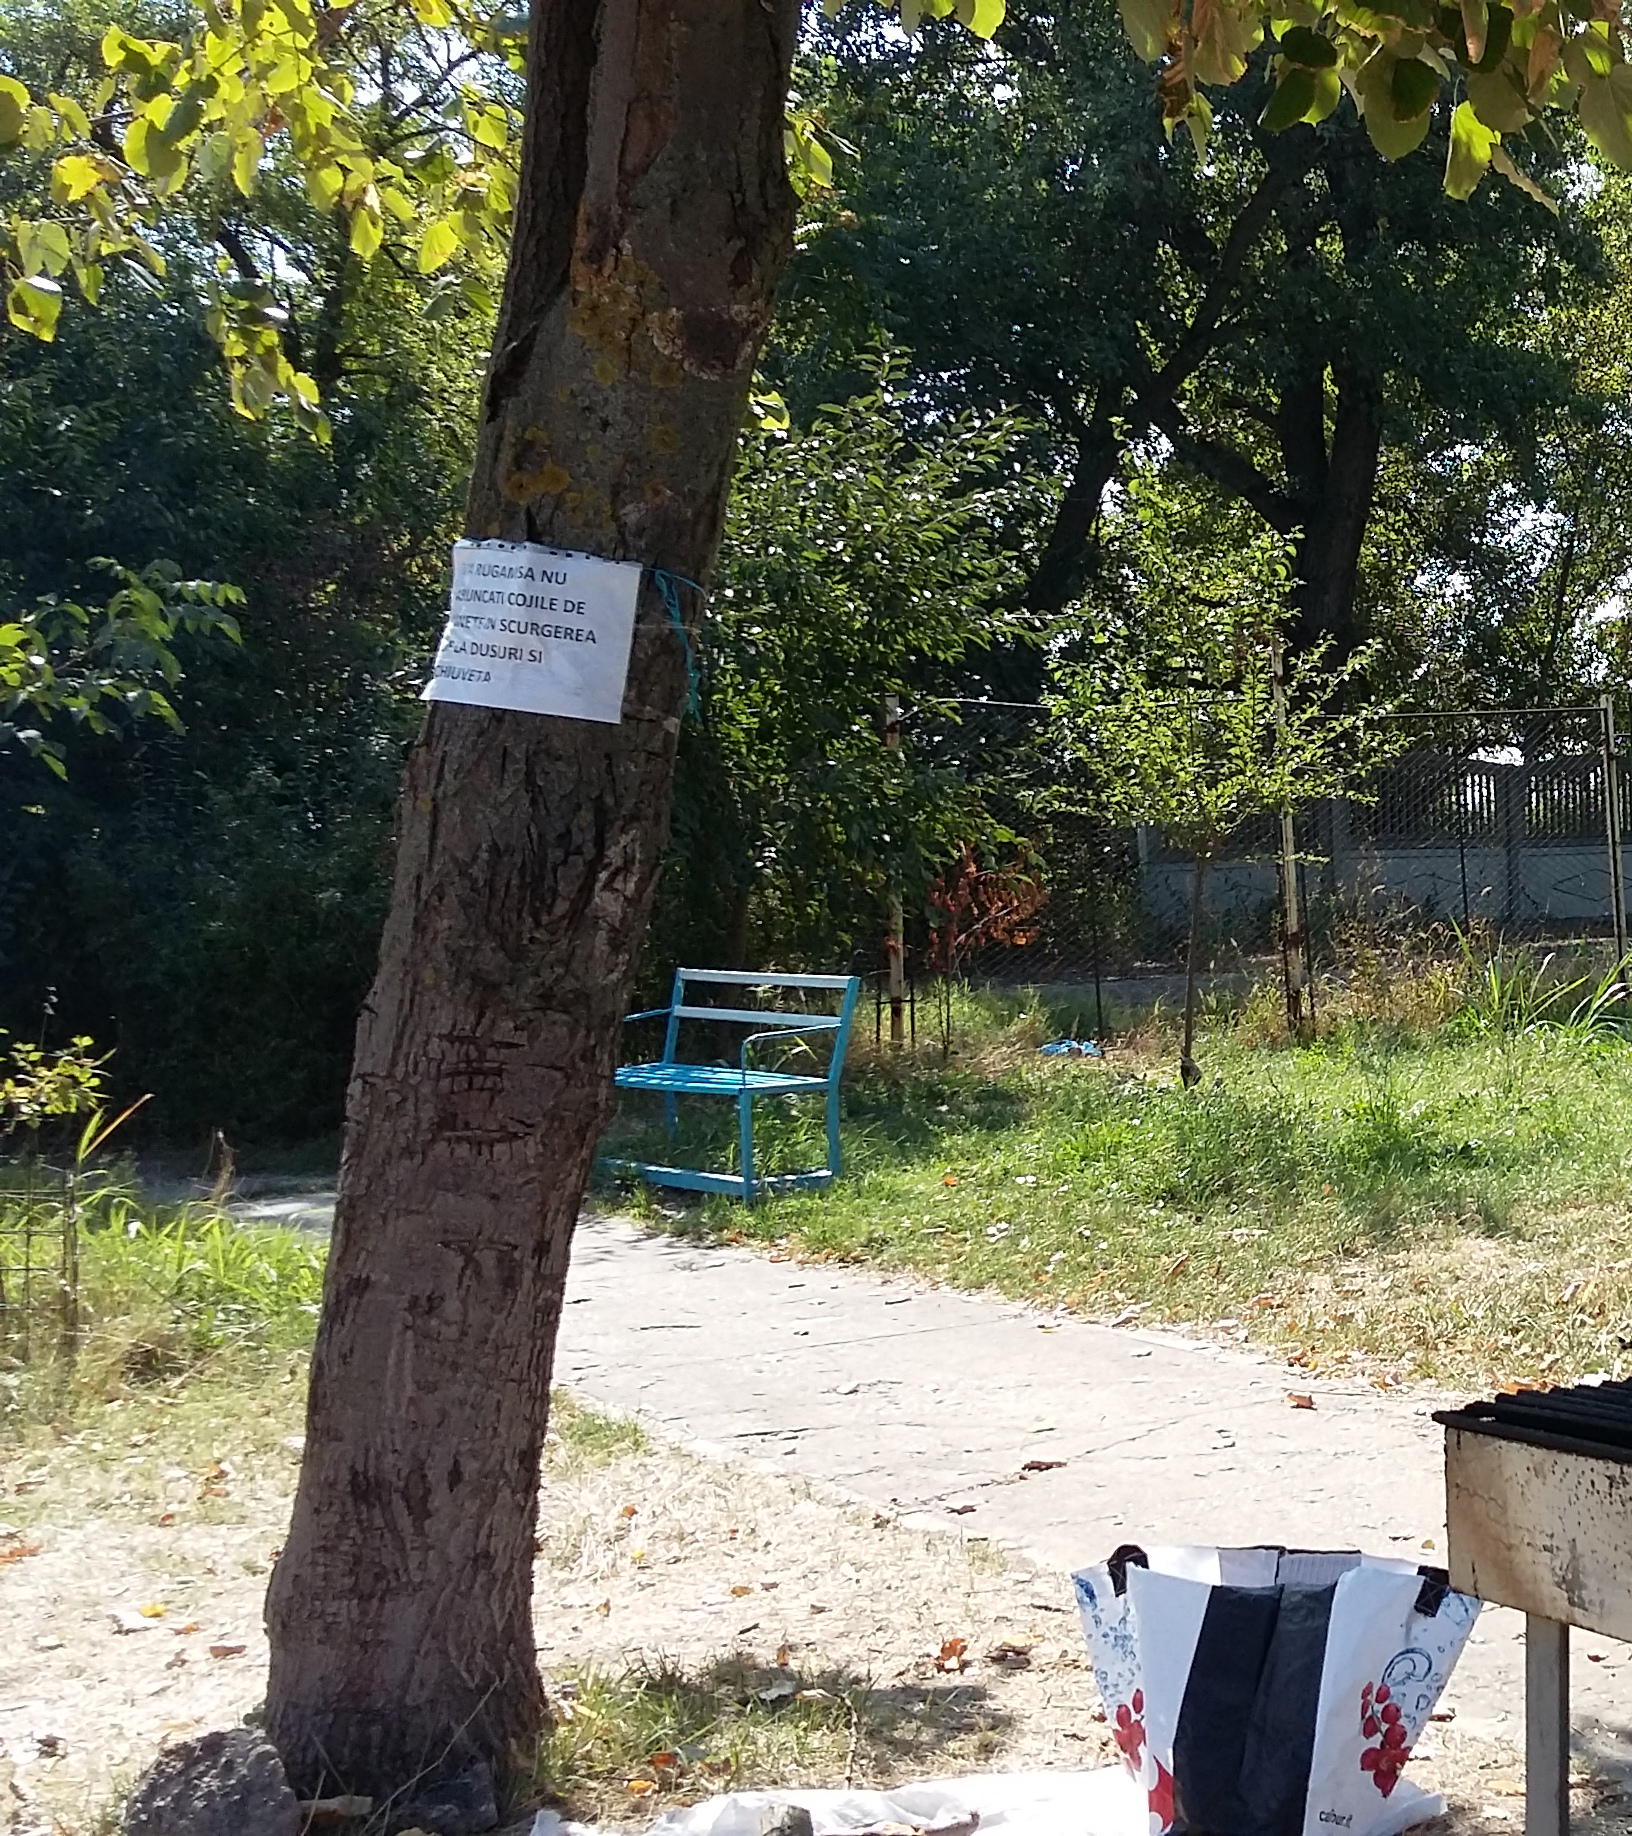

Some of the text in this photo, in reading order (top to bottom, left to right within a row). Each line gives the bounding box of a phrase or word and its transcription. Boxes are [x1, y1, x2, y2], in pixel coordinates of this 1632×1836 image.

[540, 569, 568, 585] NU
[507, 592, 559, 611] COJILE
[562, 599, 586, 615] DE
[499, 618, 597, 644] SCURGEREA
[469, 641, 524, 661] DUSURI
[527, 649, 543, 664] SI
